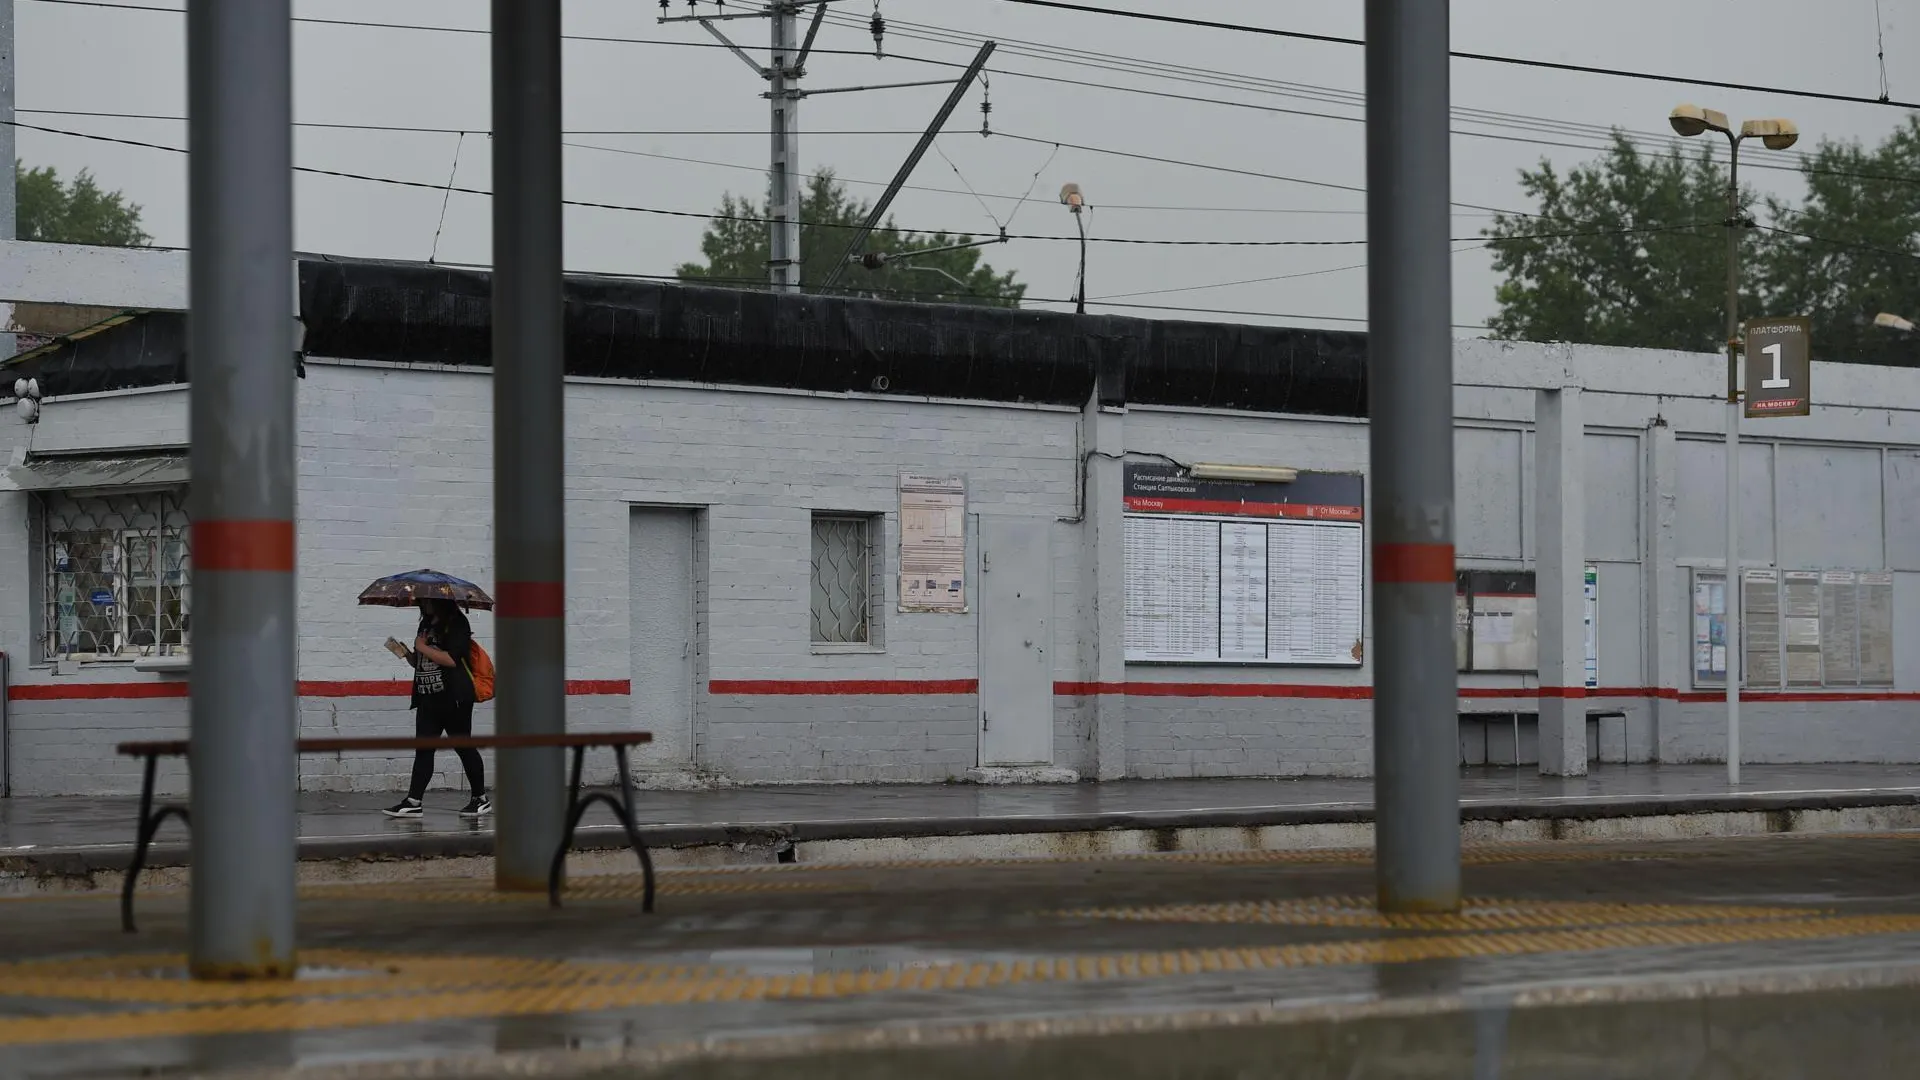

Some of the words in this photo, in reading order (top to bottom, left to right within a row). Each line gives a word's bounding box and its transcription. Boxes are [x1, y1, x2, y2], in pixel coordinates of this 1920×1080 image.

[1750, 325, 1802, 335] ПЛАТФОРМА
[1761, 343, 1790, 389] 1
[1767, 400, 1796, 408] МОСКВУ
[1133, 473, 1166, 482] Расписание
[1133, 483, 1157, 492] Станция
[1157, 484, 1197, 493] Салтыковская
[1142, 499, 1164, 509] Москву
[1329, 507, 1351, 515] Москвы
[420, 674, 442, 684] YORK
